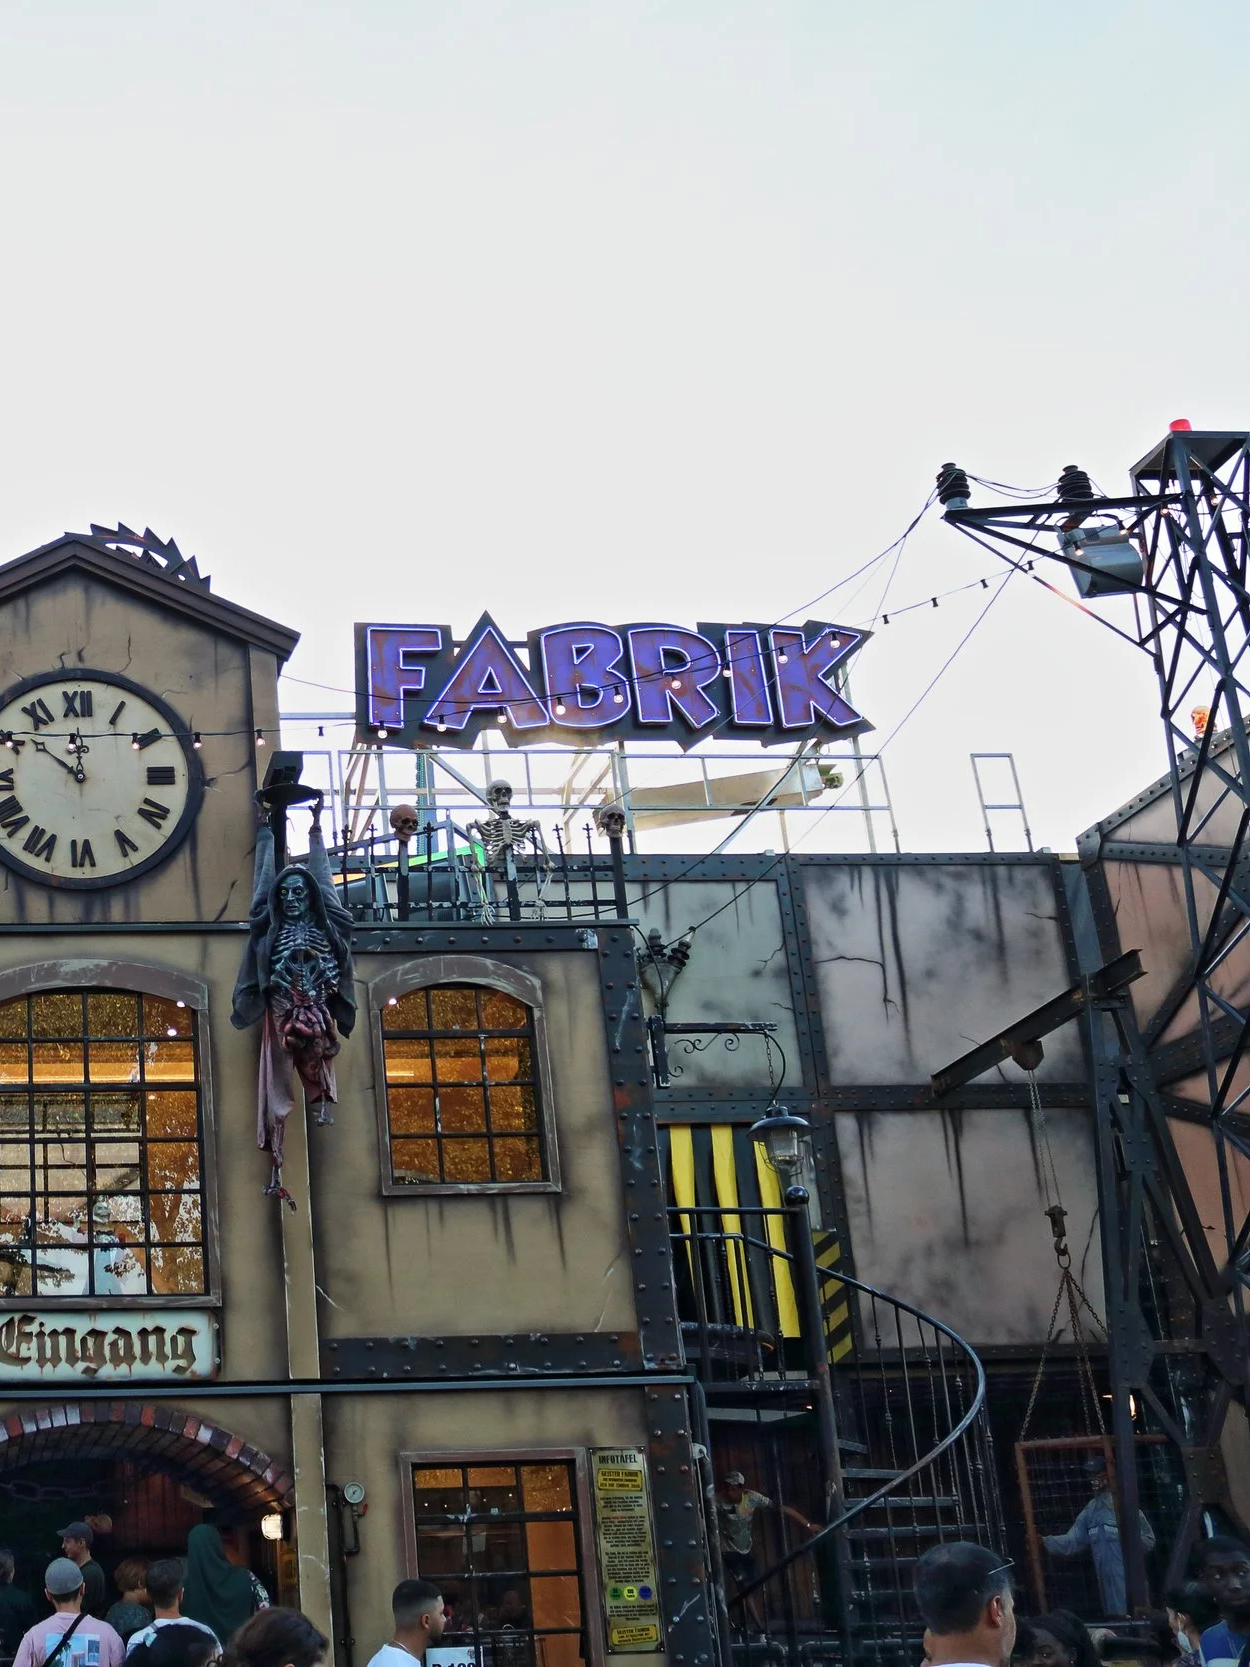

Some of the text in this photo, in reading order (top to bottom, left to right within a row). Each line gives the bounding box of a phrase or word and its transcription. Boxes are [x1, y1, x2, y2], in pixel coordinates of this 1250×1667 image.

[366, 624, 864, 730] FABRIK
[62, 690, 93, 718] XII
[598, 1454, 637, 1464] INFOTAFEL
